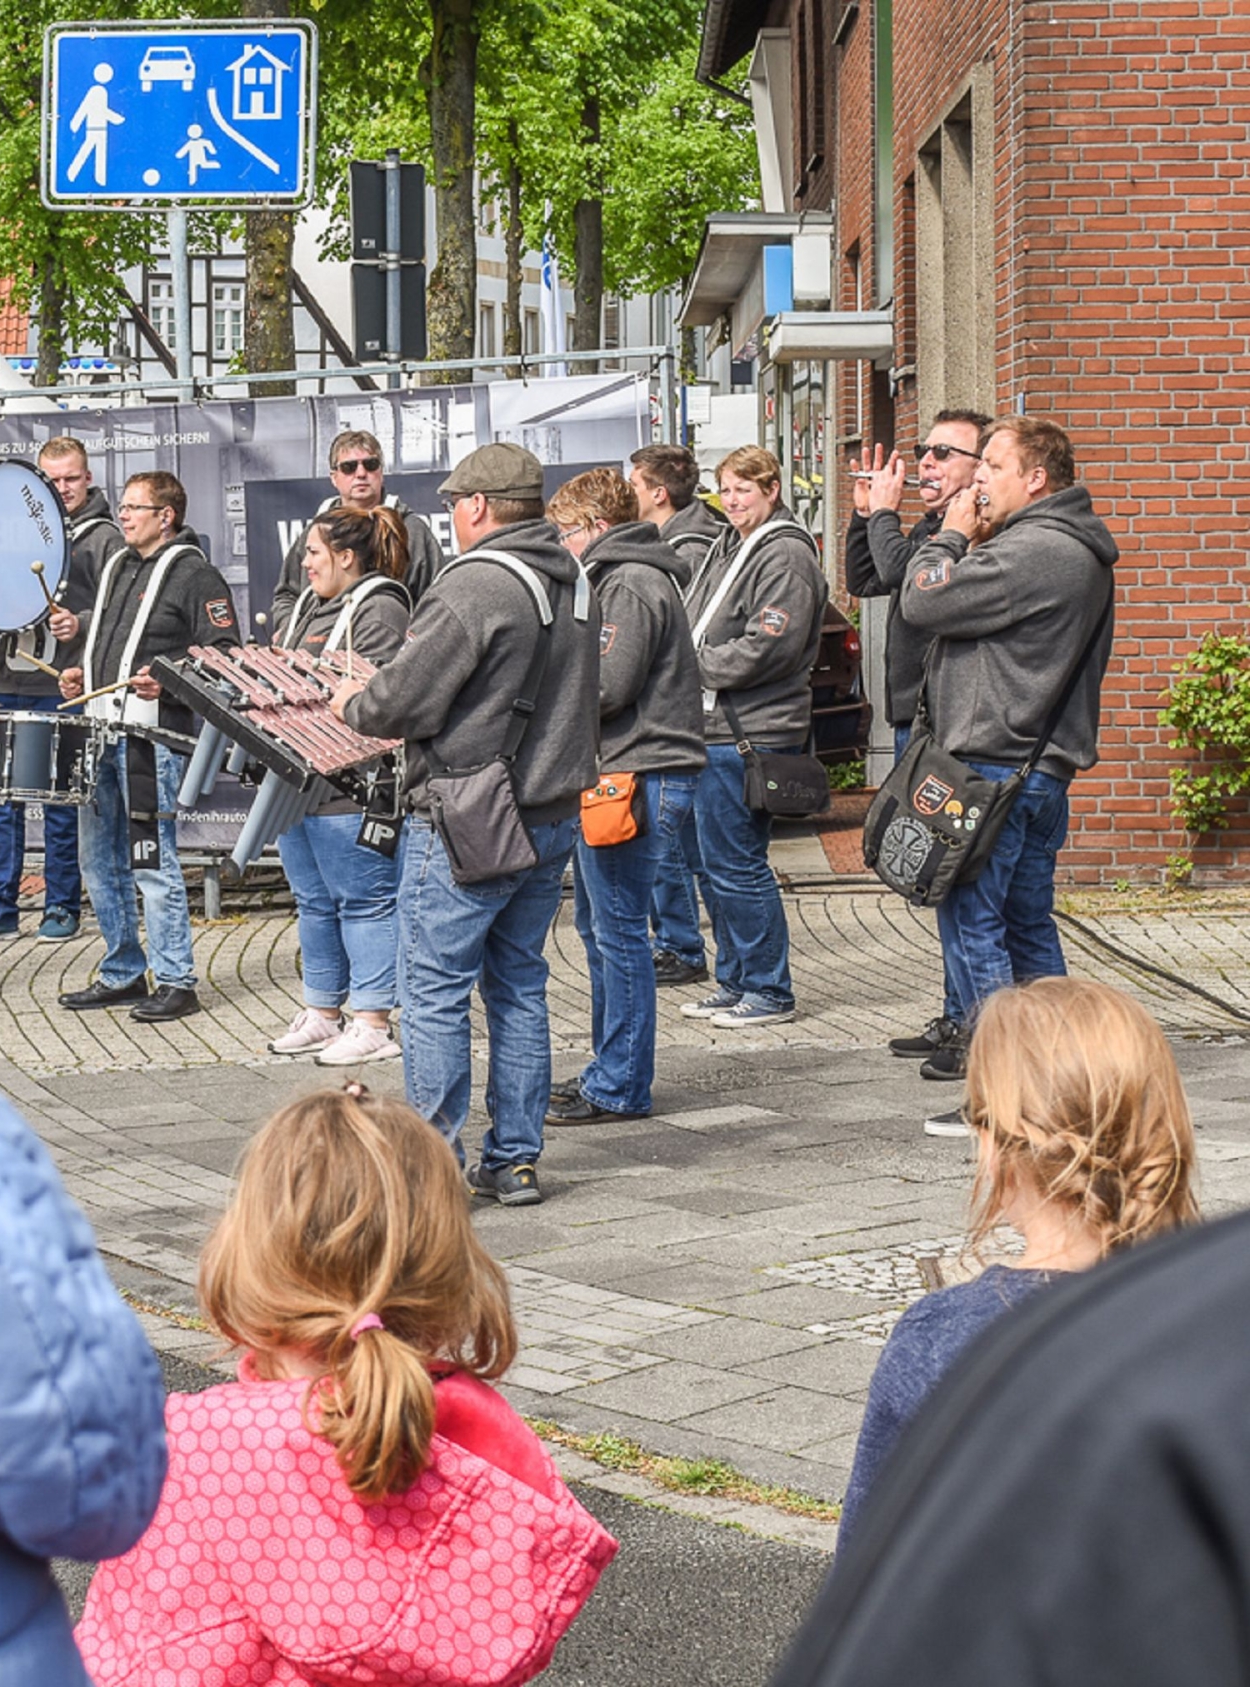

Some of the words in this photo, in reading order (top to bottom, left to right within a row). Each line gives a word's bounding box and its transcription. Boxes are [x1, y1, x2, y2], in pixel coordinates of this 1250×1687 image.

[12, 441, 26, 453] ZU
[81, 434, 161, 450] AUFGUTSCHEIN
[163, 431, 210, 446] SICHERN!
[21, 484, 54, 548] majestic
